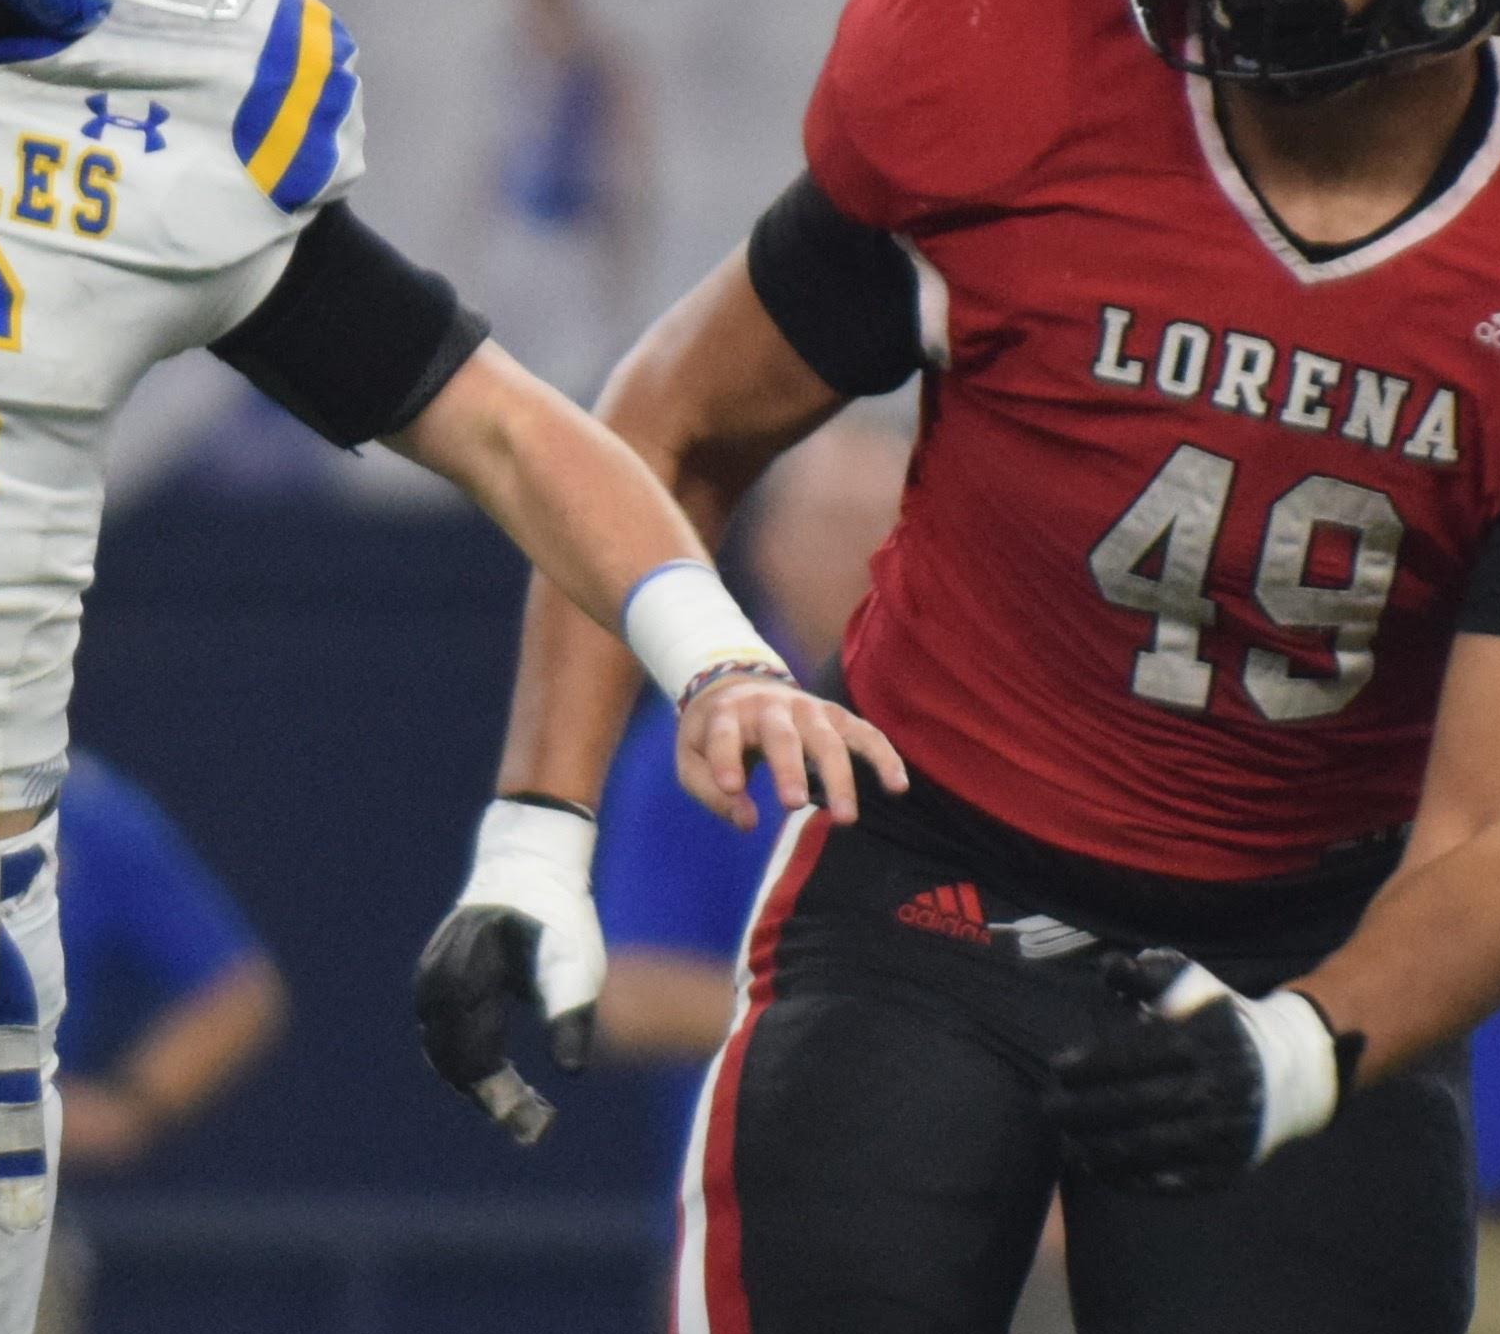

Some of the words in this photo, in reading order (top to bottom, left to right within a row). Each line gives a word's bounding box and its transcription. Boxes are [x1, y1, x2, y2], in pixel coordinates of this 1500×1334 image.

[1092, 304, 1461, 464] LORENA
[1088, 441, 1405, 722] 49
[895, 902, 992, 947] adidas
